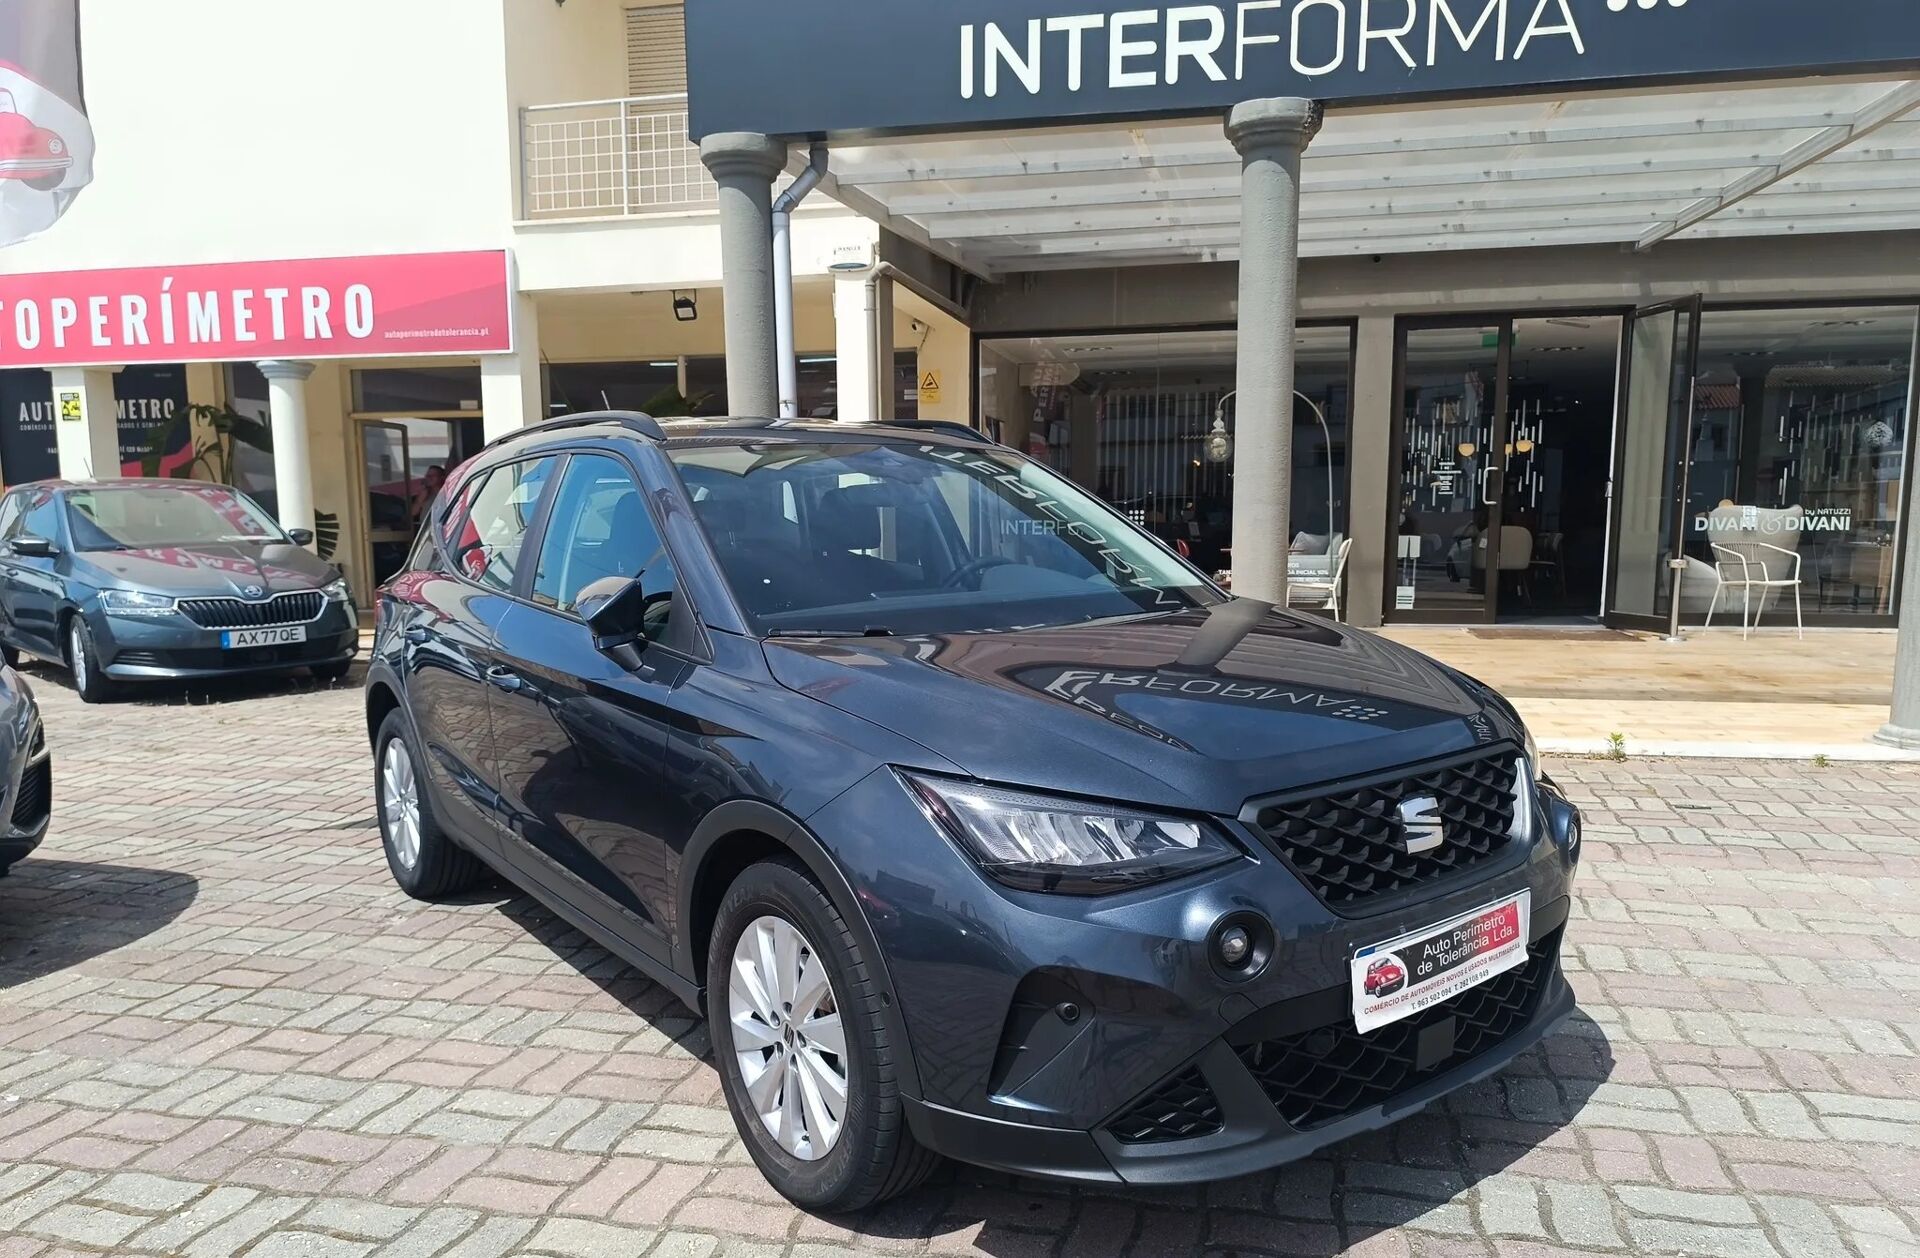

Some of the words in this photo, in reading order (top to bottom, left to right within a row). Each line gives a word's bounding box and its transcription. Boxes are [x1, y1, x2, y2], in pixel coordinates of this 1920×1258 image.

[960, 0, 1586, 99] INTERFORMA
[0, 277, 374, 350] OPERÍMETRO
[1785, 516, 1851, 532] DIVANI
[1805, 508, 1816, 517] by
[1417, 961, 1433, 976] de
[1436, 935, 1490, 967] Tolerância
[1493, 925, 1515, 942] Lda.
[1423, 938, 1451, 959] Auto
[1364, 997, 1400, 1015] COMÉRCIO
[1401, 994, 1409, 1002] DE
[1446, 969, 1464, 983] NOVOS
[1468, 957, 1488, 972] USADOS
[1417, 998, 1429, 1008] 963
[1430, 993, 1441, 1003] 502
